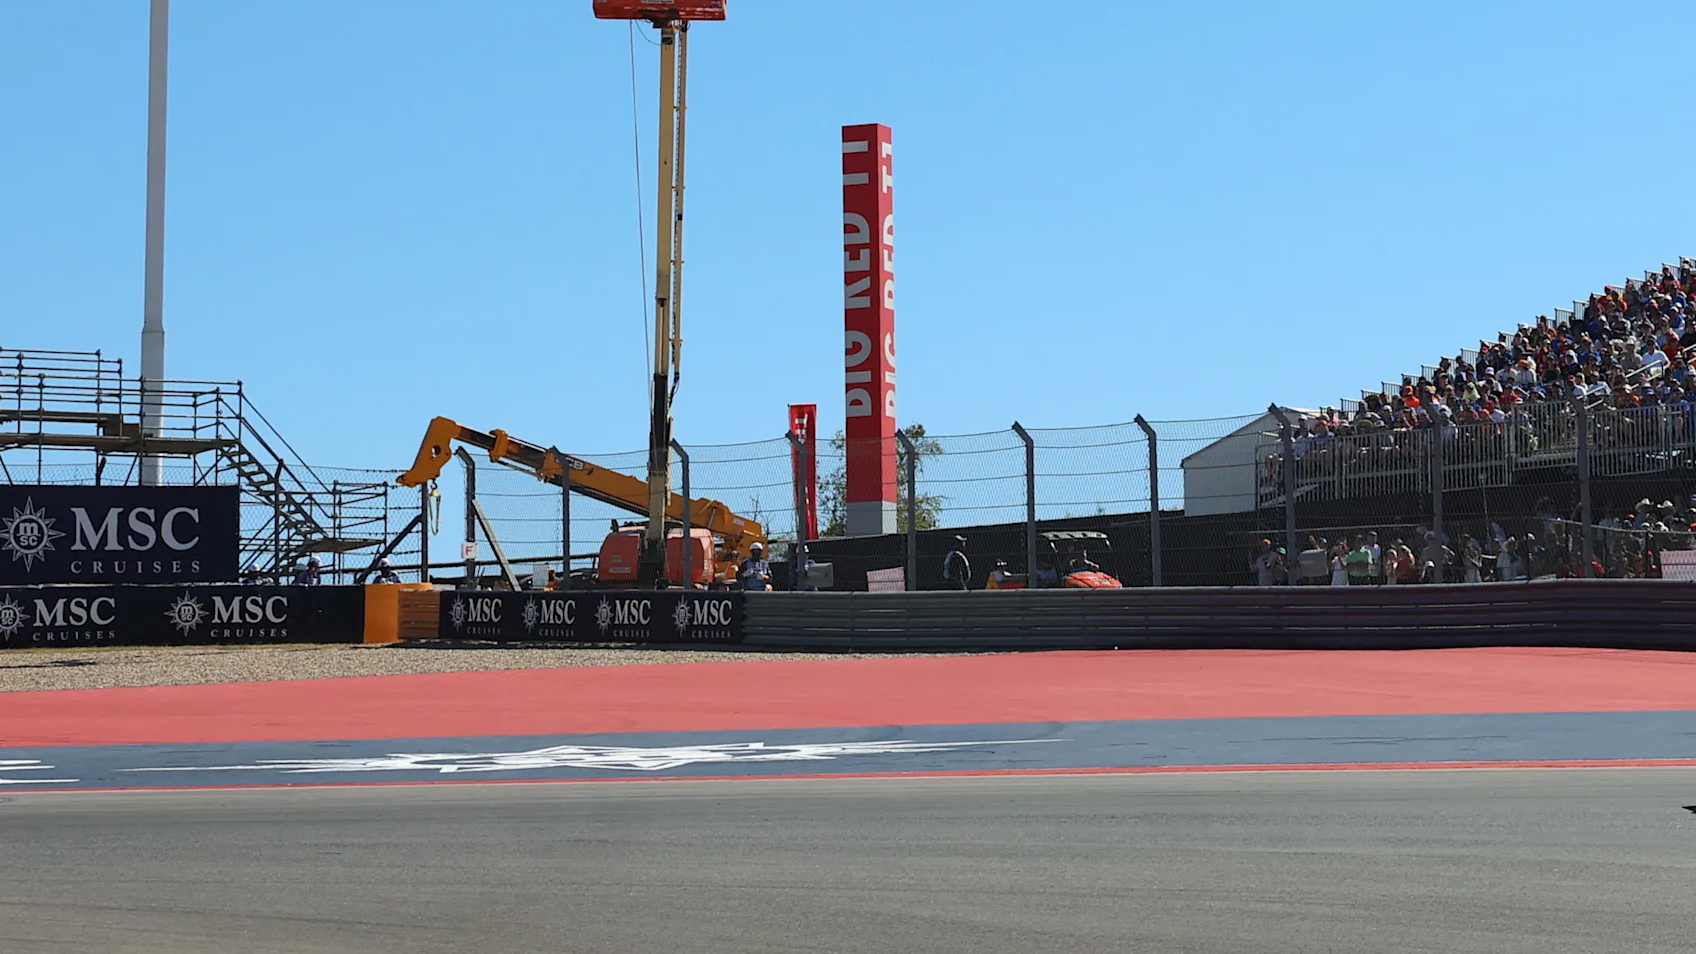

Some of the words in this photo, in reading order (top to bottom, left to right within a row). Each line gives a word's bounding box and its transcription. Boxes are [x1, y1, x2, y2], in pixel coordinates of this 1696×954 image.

[70, 507, 199, 551] MSC
[465, 546, 473, 556] F
[70, 561, 200, 574] CRUISES
[33, 597, 115, 626] MSC
[211, 596, 288, 623] MSC
[467, 598, 502, 622] MSC
[540, 600, 575, 624] MSC
[614, 600, 651, 625] MSC
[693, 600, 732, 625] MSC
[33, 630, 115, 641] CRUISES
[210, 628, 287, 637] CRUISES
[539, 629, 574, 637] CRUISES
[692, 630, 731, 638] CRUISES
